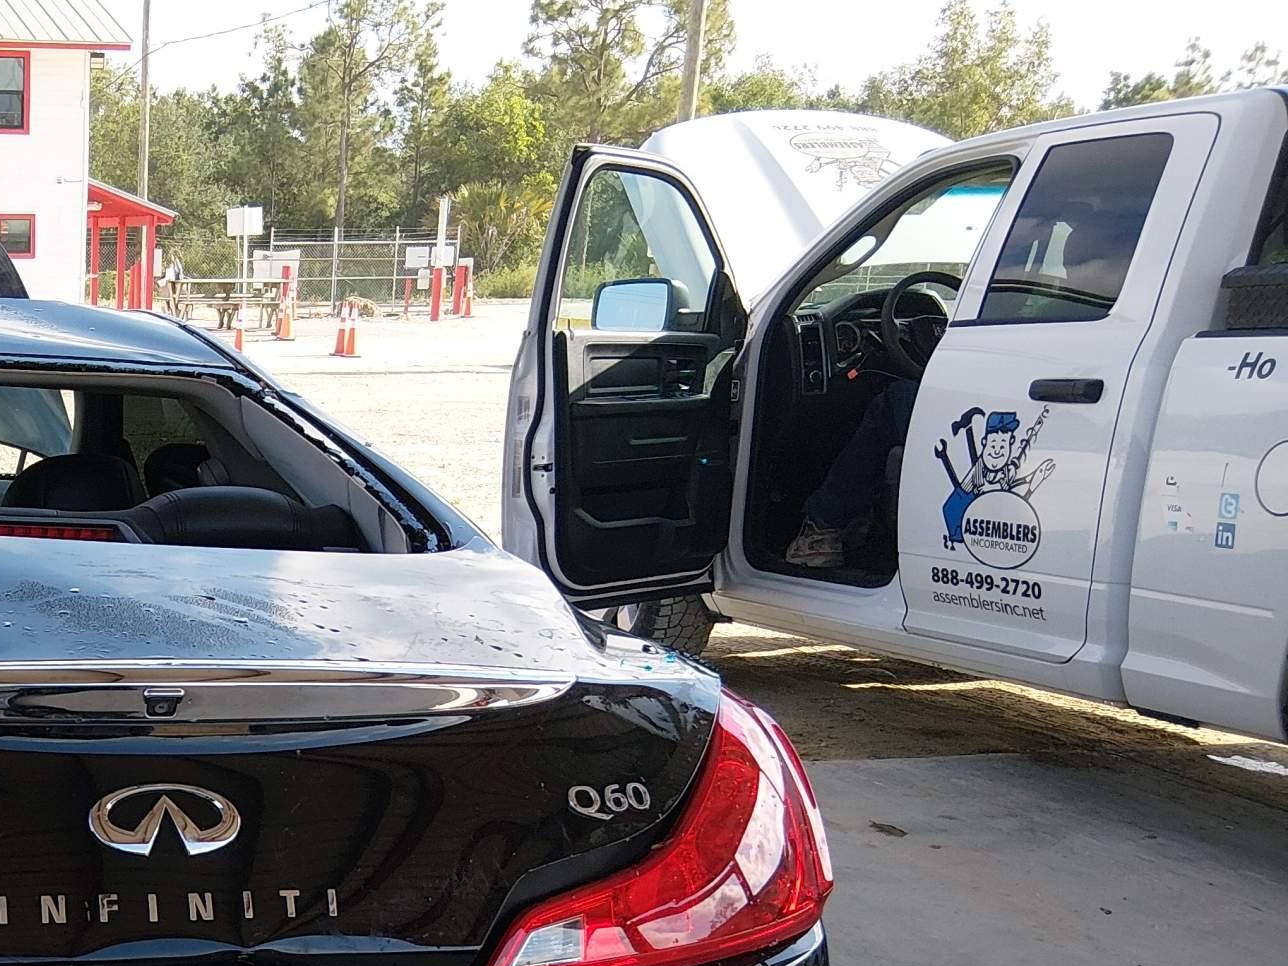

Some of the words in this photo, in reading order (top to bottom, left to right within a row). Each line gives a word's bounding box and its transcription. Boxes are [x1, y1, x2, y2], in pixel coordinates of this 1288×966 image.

[1227, 352, 1277, 380] -Ho
[1167, 503, 1182, 513] VISA
[964, 517, 1037, 544] ASSEMBLERS
[971, 537, 1028, 554] INCORPORATED
[931, 567, 1042, 600] 888-499-2720
[933, 591, 1046, 621] assemblersinc.net
[567, 782, 652, 821] Q60
